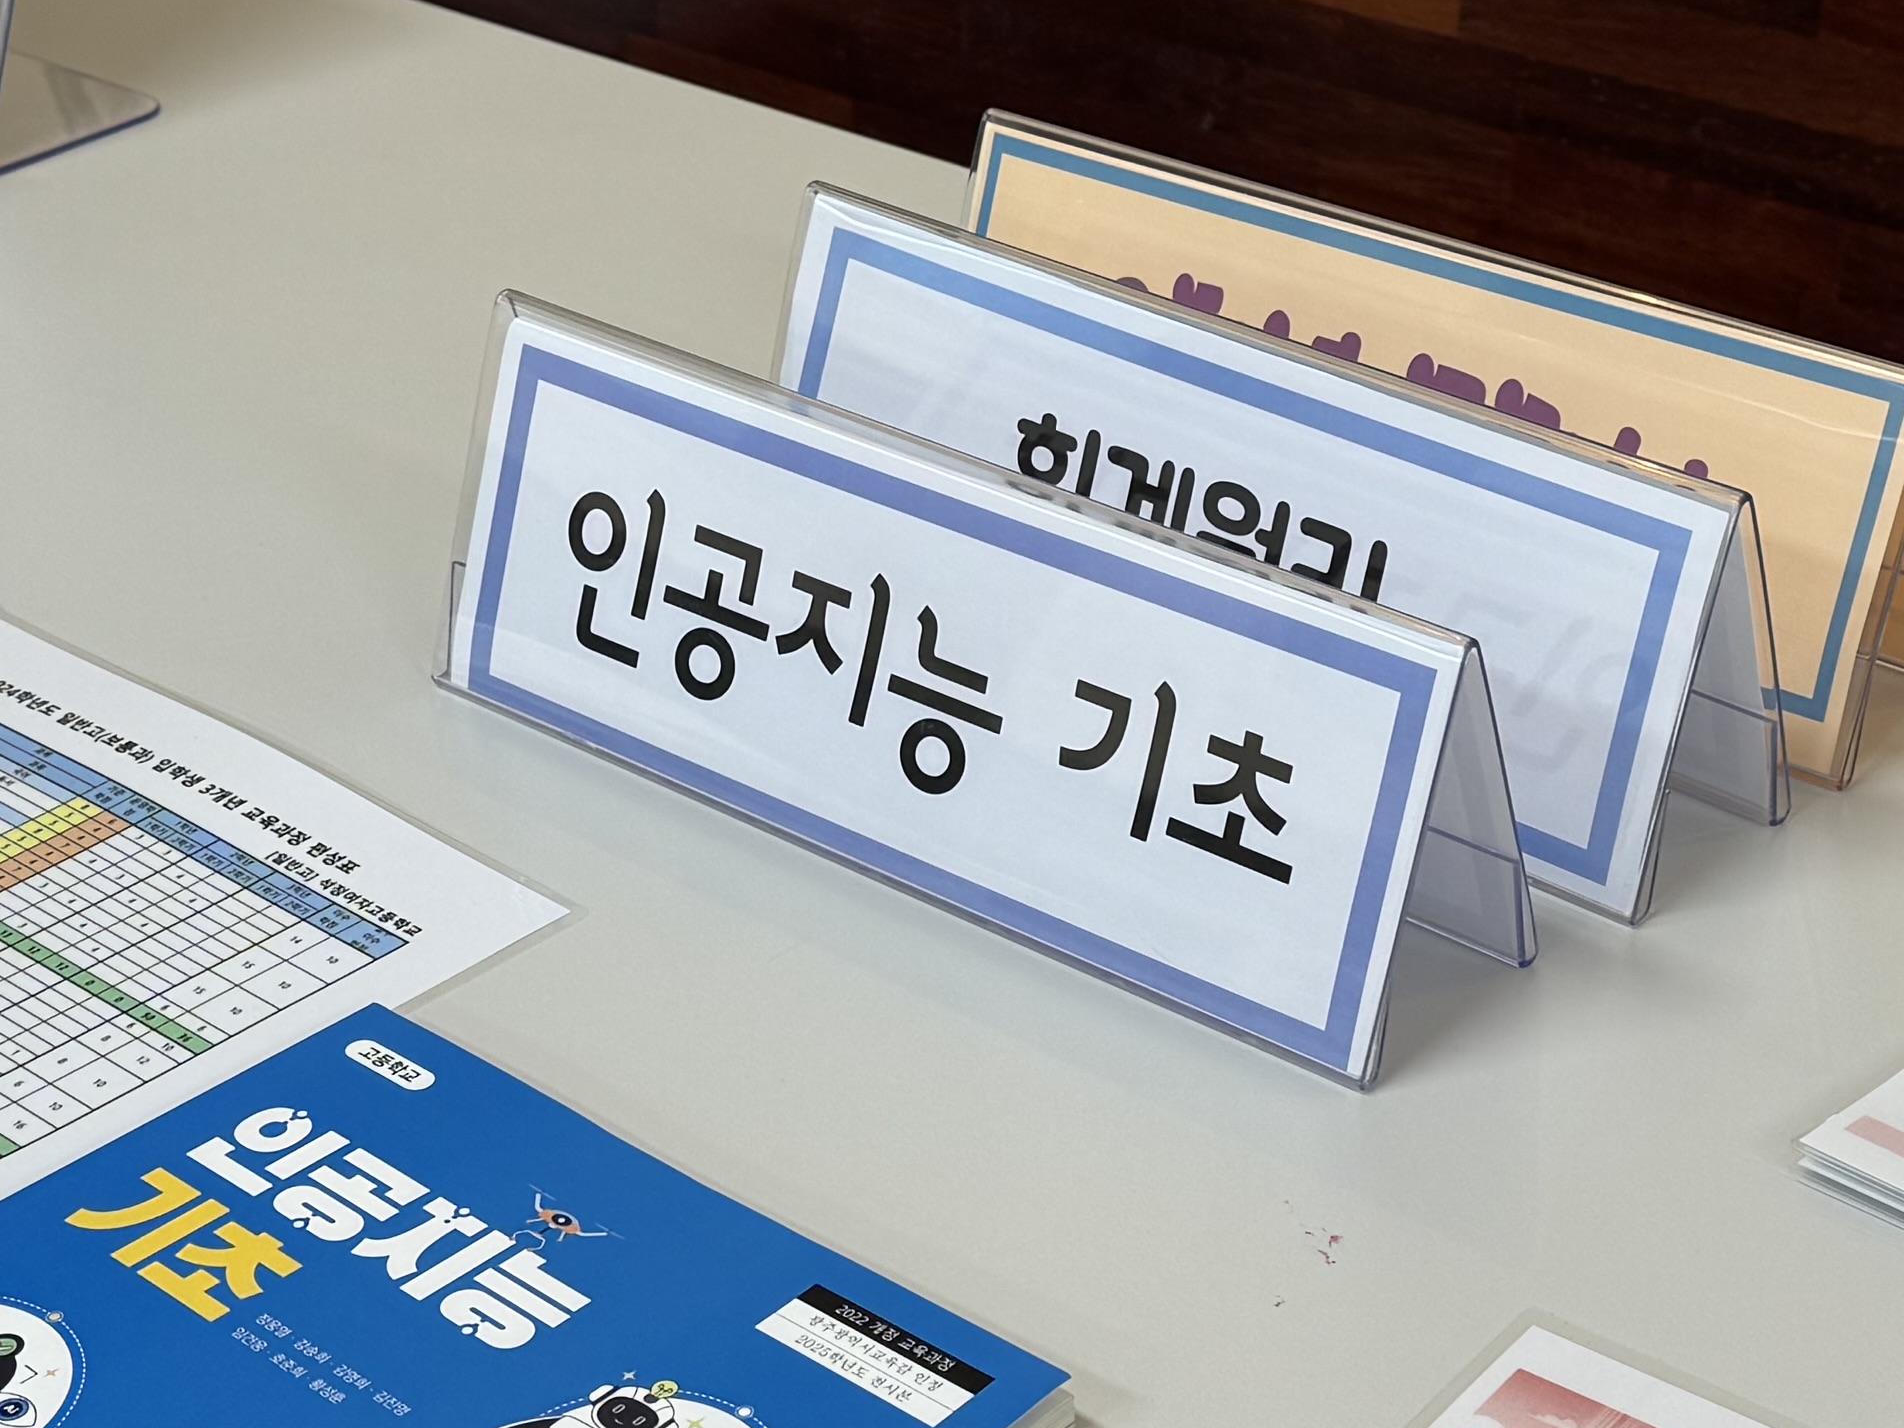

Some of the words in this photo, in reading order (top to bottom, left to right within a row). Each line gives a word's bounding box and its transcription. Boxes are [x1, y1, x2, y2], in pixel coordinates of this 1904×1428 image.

[565, 488, 1006, 797] 인공지능
[1058, 676, 1297, 885] 기초
[151, 758, 206, 788] 입학생
[197, 783, 248, 811] 3개년
[239, 806, 313, 847] 교육과정
[305, 841, 361, 875] 편성표
[357, 1046, 422, 1083] 고등학교
[63, 1166, 304, 1323] 기초
[185, 1106, 592, 1349] 인공지능
[793, 1334, 870, 1379] 2025학년도
[870, 1375, 913, 1403] 전시본
[834, 1303, 870, 1326] 2022
[868, 1320, 901, 1342] 개정
[896, 1337, 956, 1372] 교육과정
